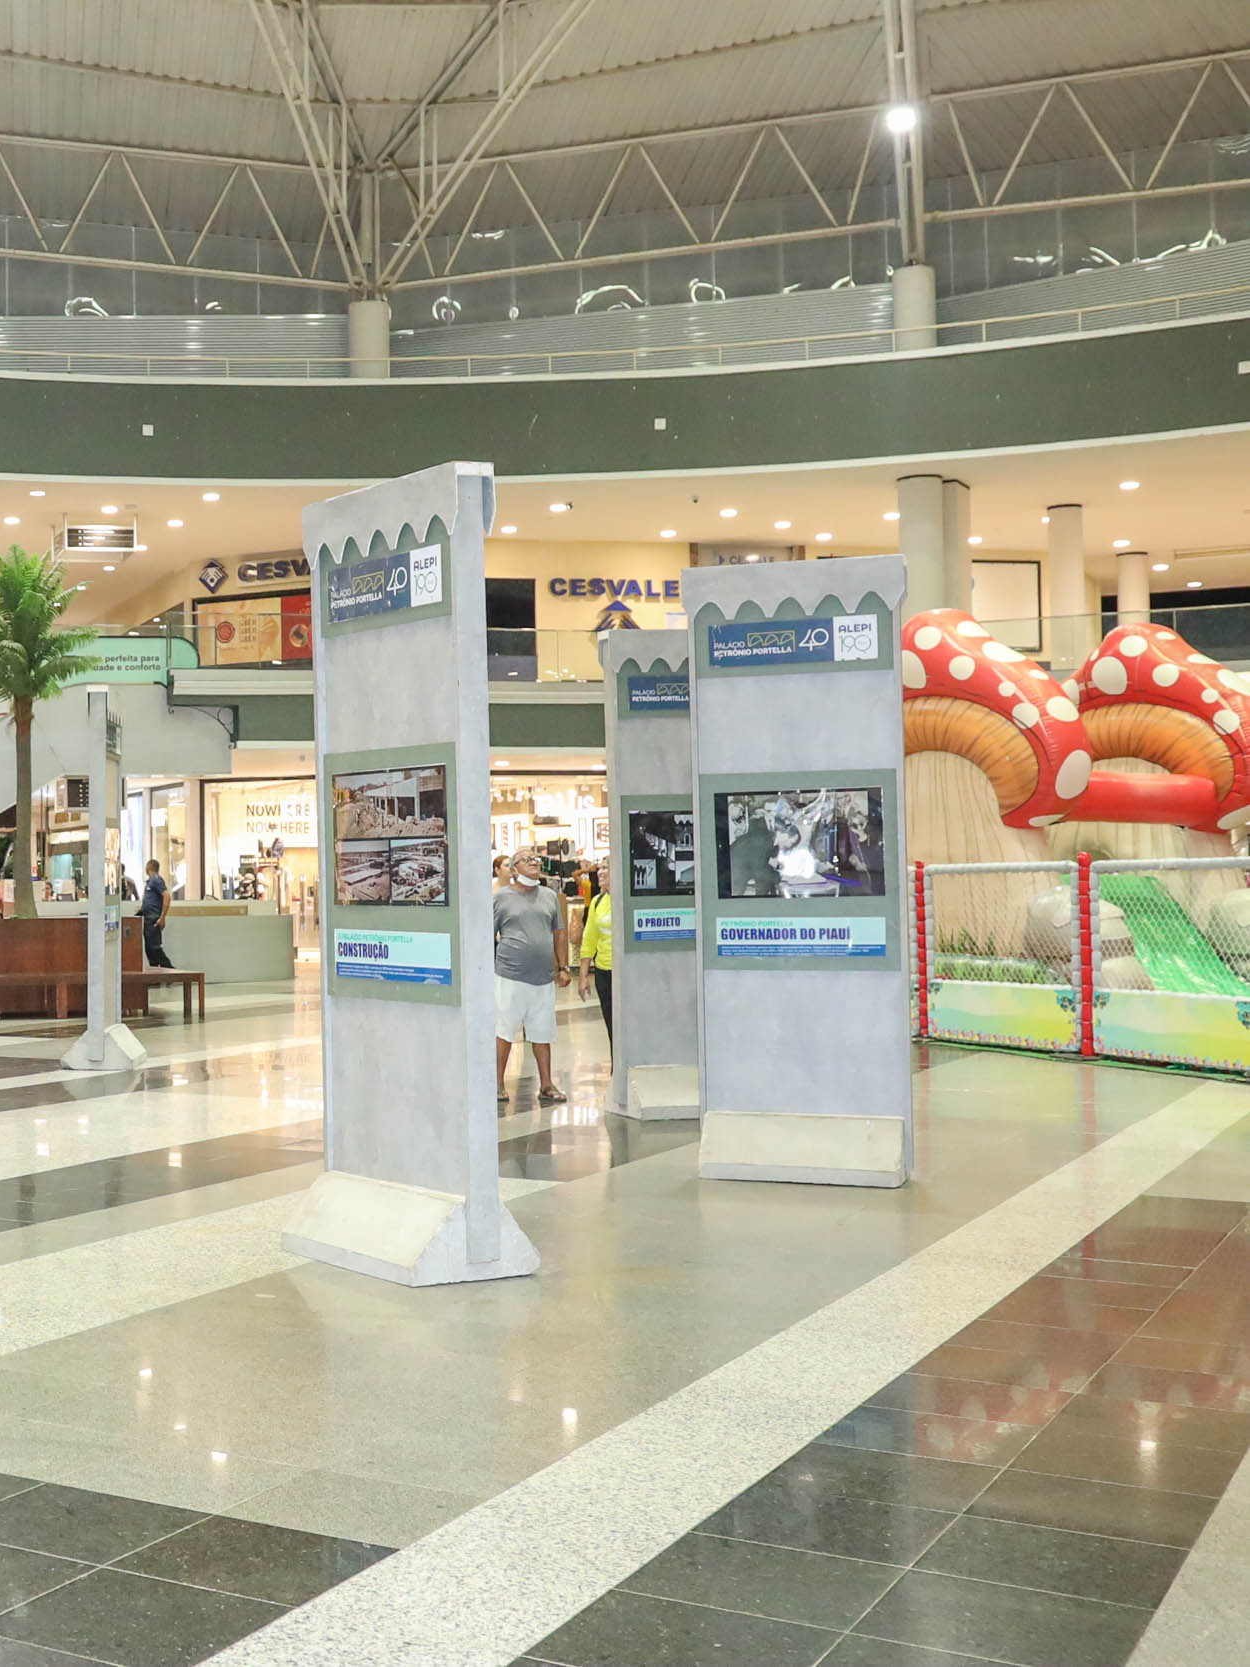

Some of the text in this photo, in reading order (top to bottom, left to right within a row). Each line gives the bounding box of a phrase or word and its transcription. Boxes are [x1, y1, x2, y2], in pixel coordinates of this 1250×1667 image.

[413, 556, 438, 571] ALEPI
[386, 566, 408, 596] 40
[549, 577, 680, 598] CESVALE
[838, 623, 873, 634] ALEPI
[713, 640, 746, 650] PALÁCIO
[798, 628, 830, 652] 40
[713, 646, 793, 658] PETRÔNIO PORTELLA
[104, 655, 161, 664] perfeita para
[124, 663, 162, 671] conforto
[637, 917, 681, 928] O PROJETO
[721, 926, 850, 940] GOVERNADOR DO PIAUÍ
[338, 941, 389, 961] CONSTRUÇÃO
